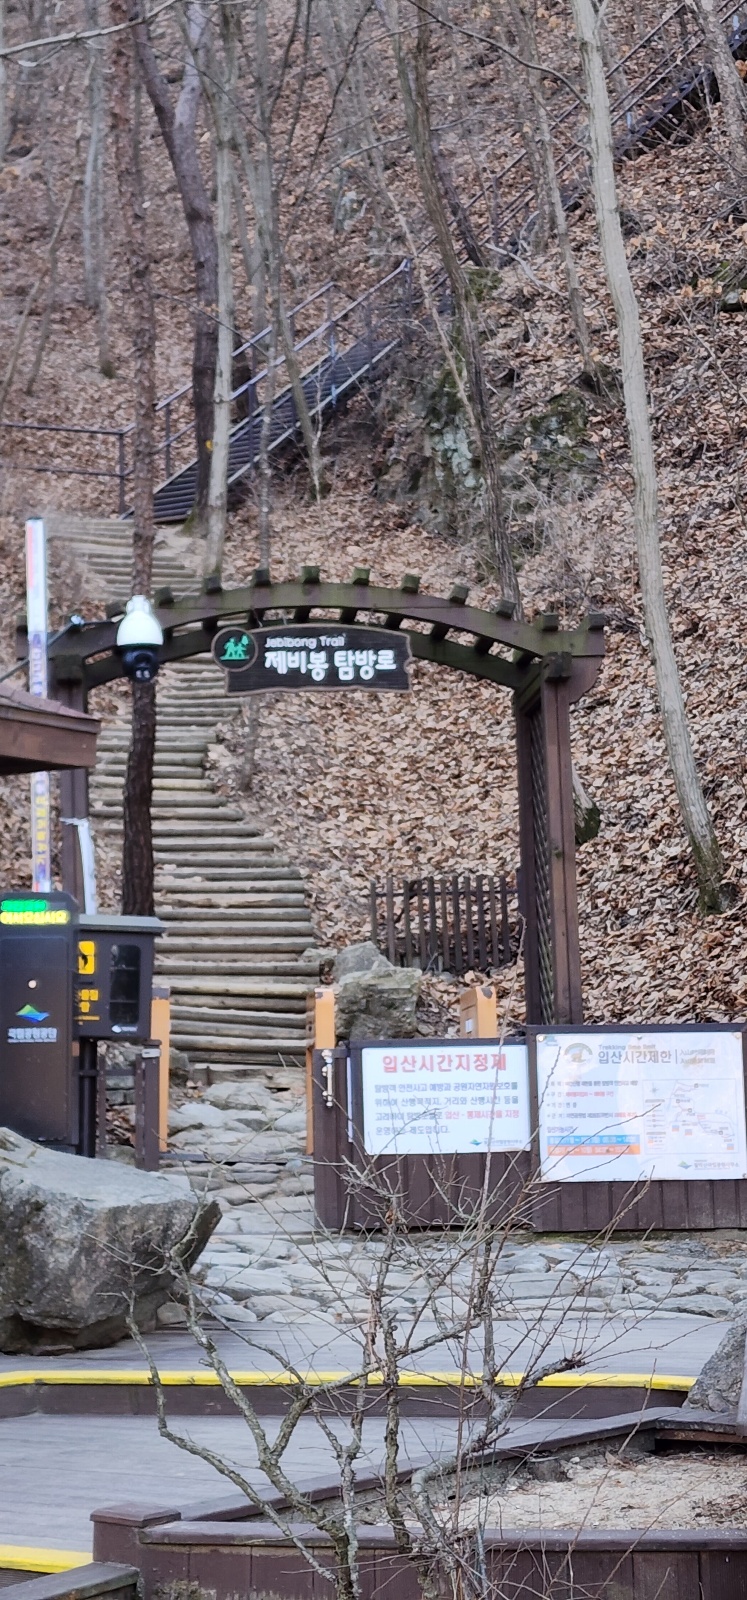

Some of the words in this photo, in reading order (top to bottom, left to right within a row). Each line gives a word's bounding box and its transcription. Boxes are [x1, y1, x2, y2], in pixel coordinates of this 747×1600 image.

[265, 636, 317, 649] Jebibong
[319, 635, 345, 647] Trail
[264, 650, 329, 681] 제비봉
[333, 649, 397, 681] 탐방로
[382, 1053, 507, 1073] 입산시간지정제
[598, 1050, 672, 1065] 입산시간제한
[444, 1096, 468, 1105] 거리와
[504, 1095, 519, 1104] 등을
[505, 1109, 520, 1118] 지정
